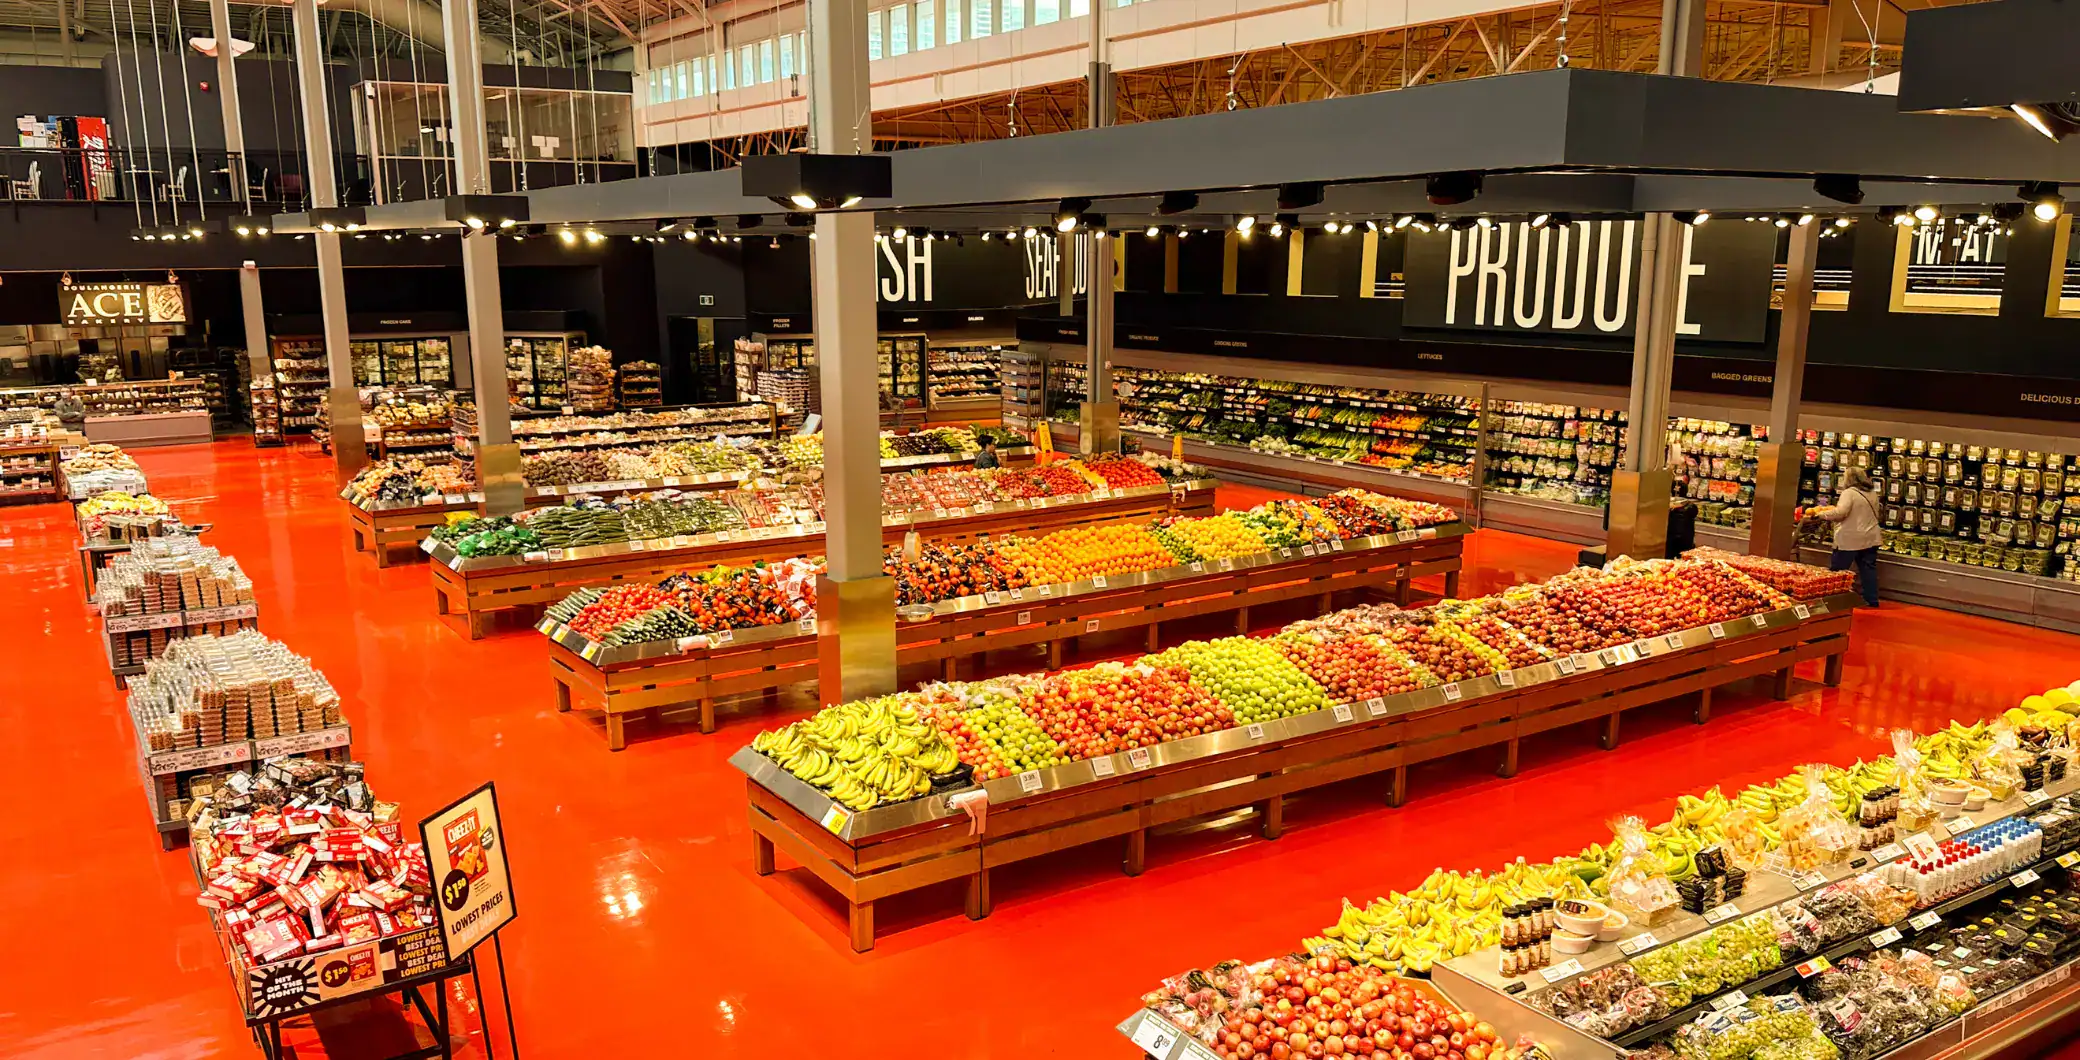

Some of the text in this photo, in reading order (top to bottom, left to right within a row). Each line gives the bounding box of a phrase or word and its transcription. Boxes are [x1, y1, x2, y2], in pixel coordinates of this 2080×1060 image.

[1916, 219, 1996, 266] MAT
[1445, 220, 1706, 335] PRODUE
[67, 292, 144, 318] ACE
[1711, 372, 1773, 383] BAGGED GREENS
[2020, 393, 2072, 405] DELICIOUS
[451, 908, 480, 936] LOWEST
[480, 891, 504, 915] PRICES
[397, 931, 427, 946] LOWEST
[405, 941, 424, 952] BEST
[399, 947, 429, 961] LOWEST
[407, 957, 426, 968] BEST
[400, 963, 431, 978] LOWEST
[266, 979, 303, 993] OF THE
[274, 975, 293, 985] HIT
[267, 986, 304, 1001] MONTH
